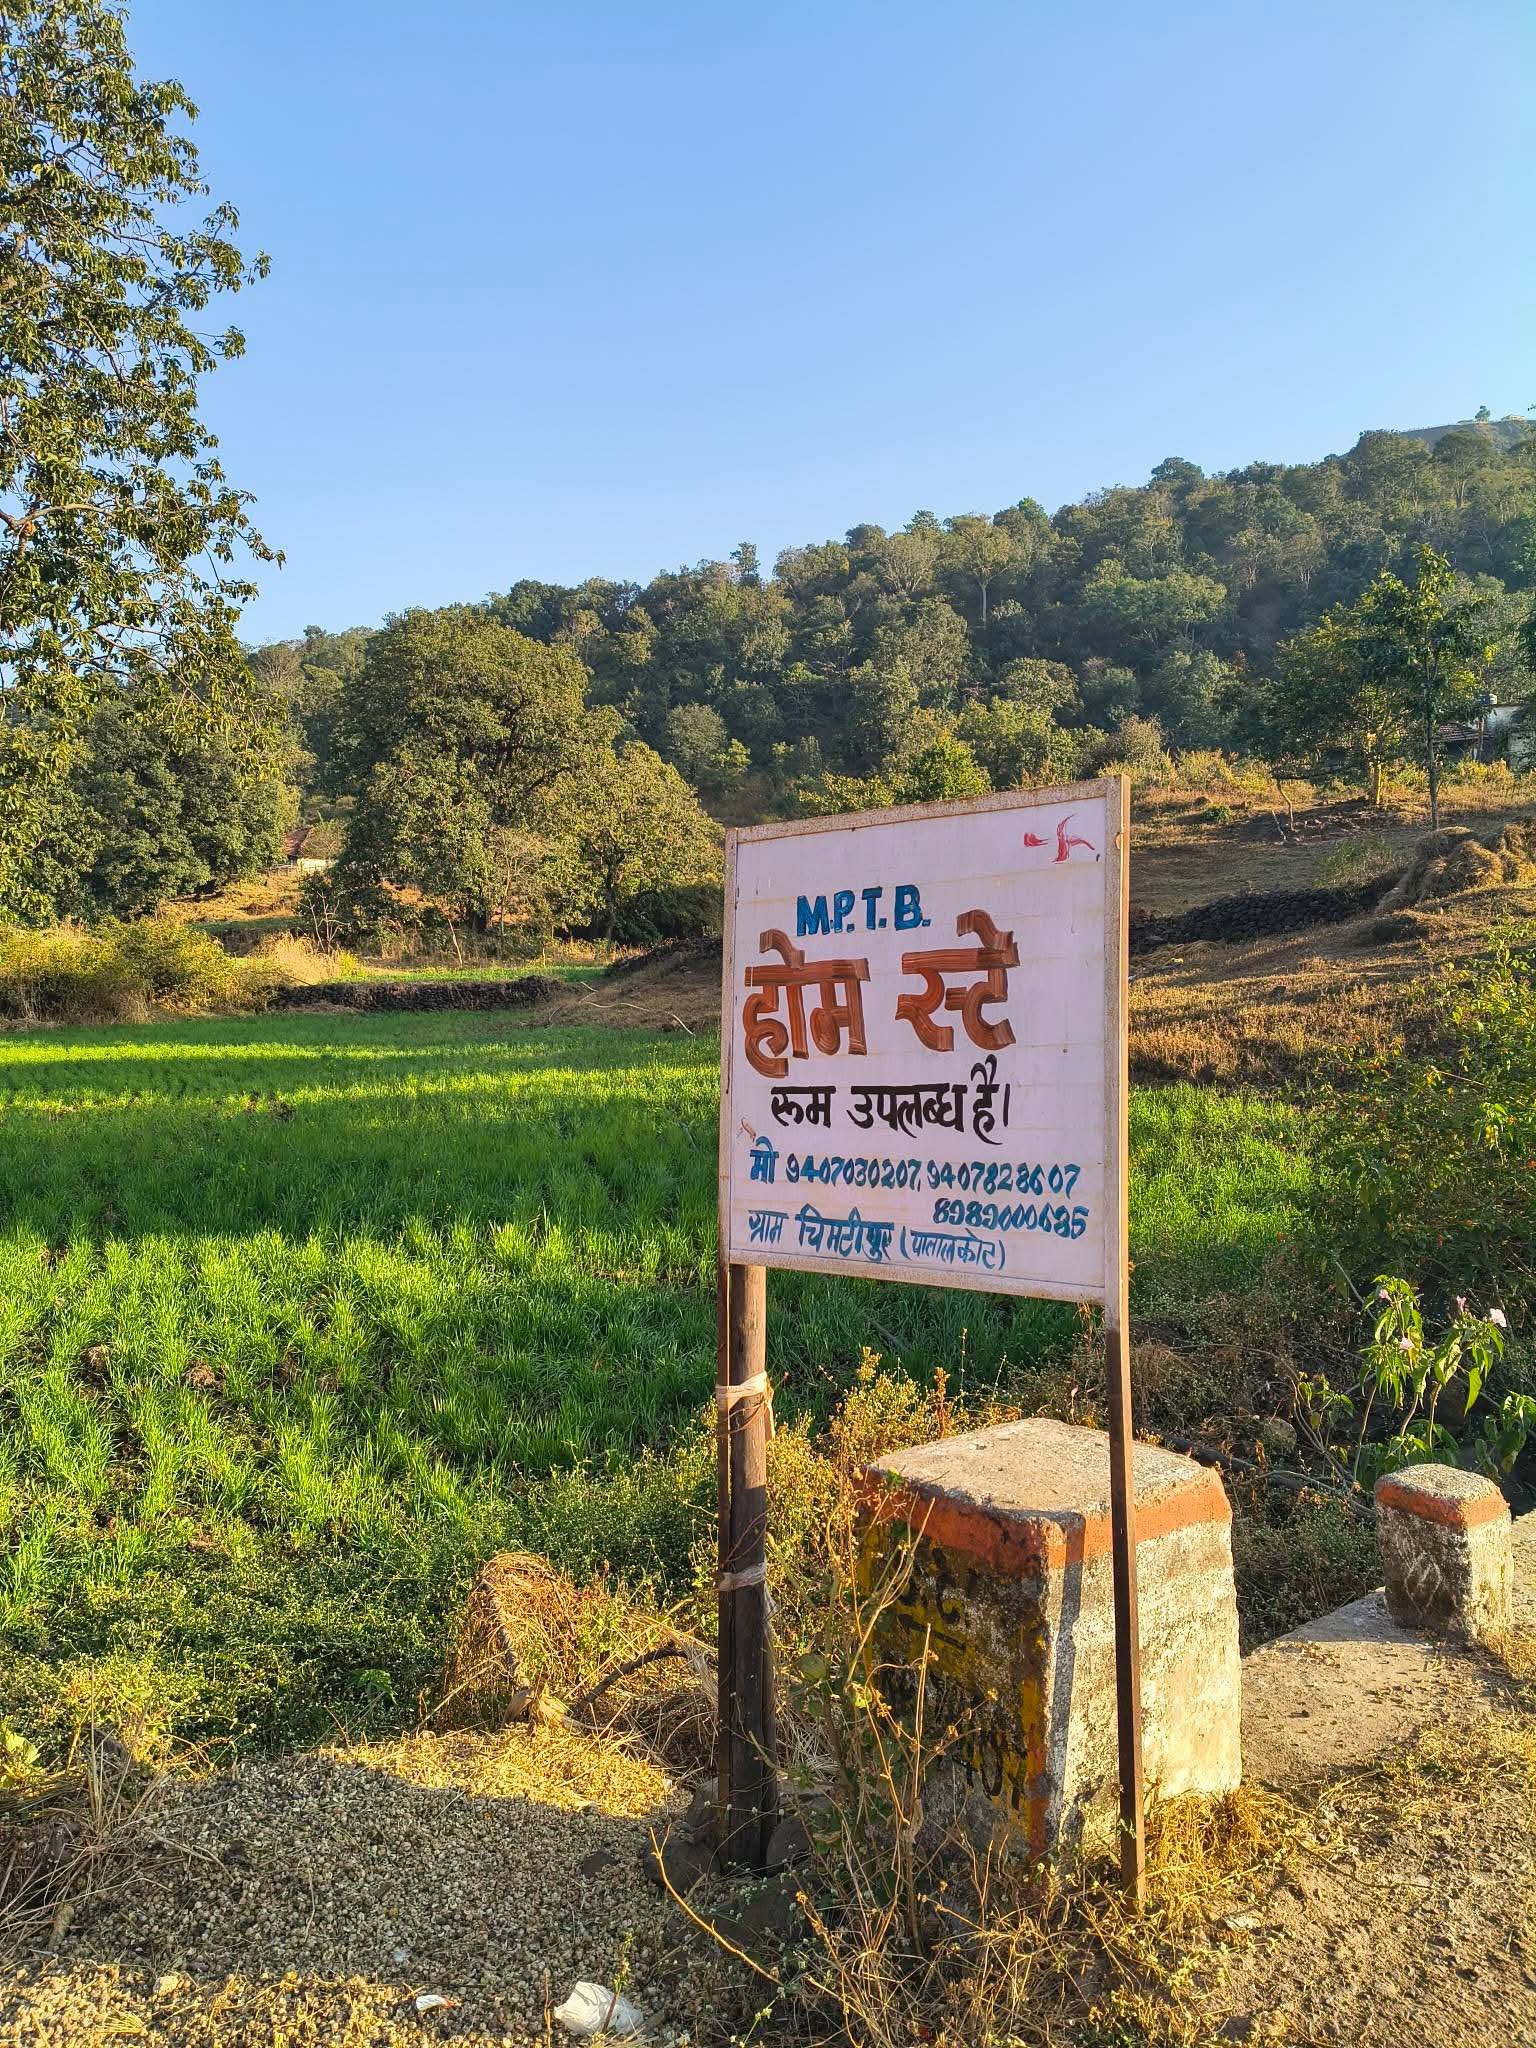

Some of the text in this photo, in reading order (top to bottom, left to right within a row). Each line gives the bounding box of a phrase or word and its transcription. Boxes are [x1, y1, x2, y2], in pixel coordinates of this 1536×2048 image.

[796, 884, 931, 936] M.P.T.B.
[742, 908, 1020, 1078] होम स्टे
[770, 1085, 836, 1129] रूम
[846, 1082, 967, 1139] उपलब्ध
